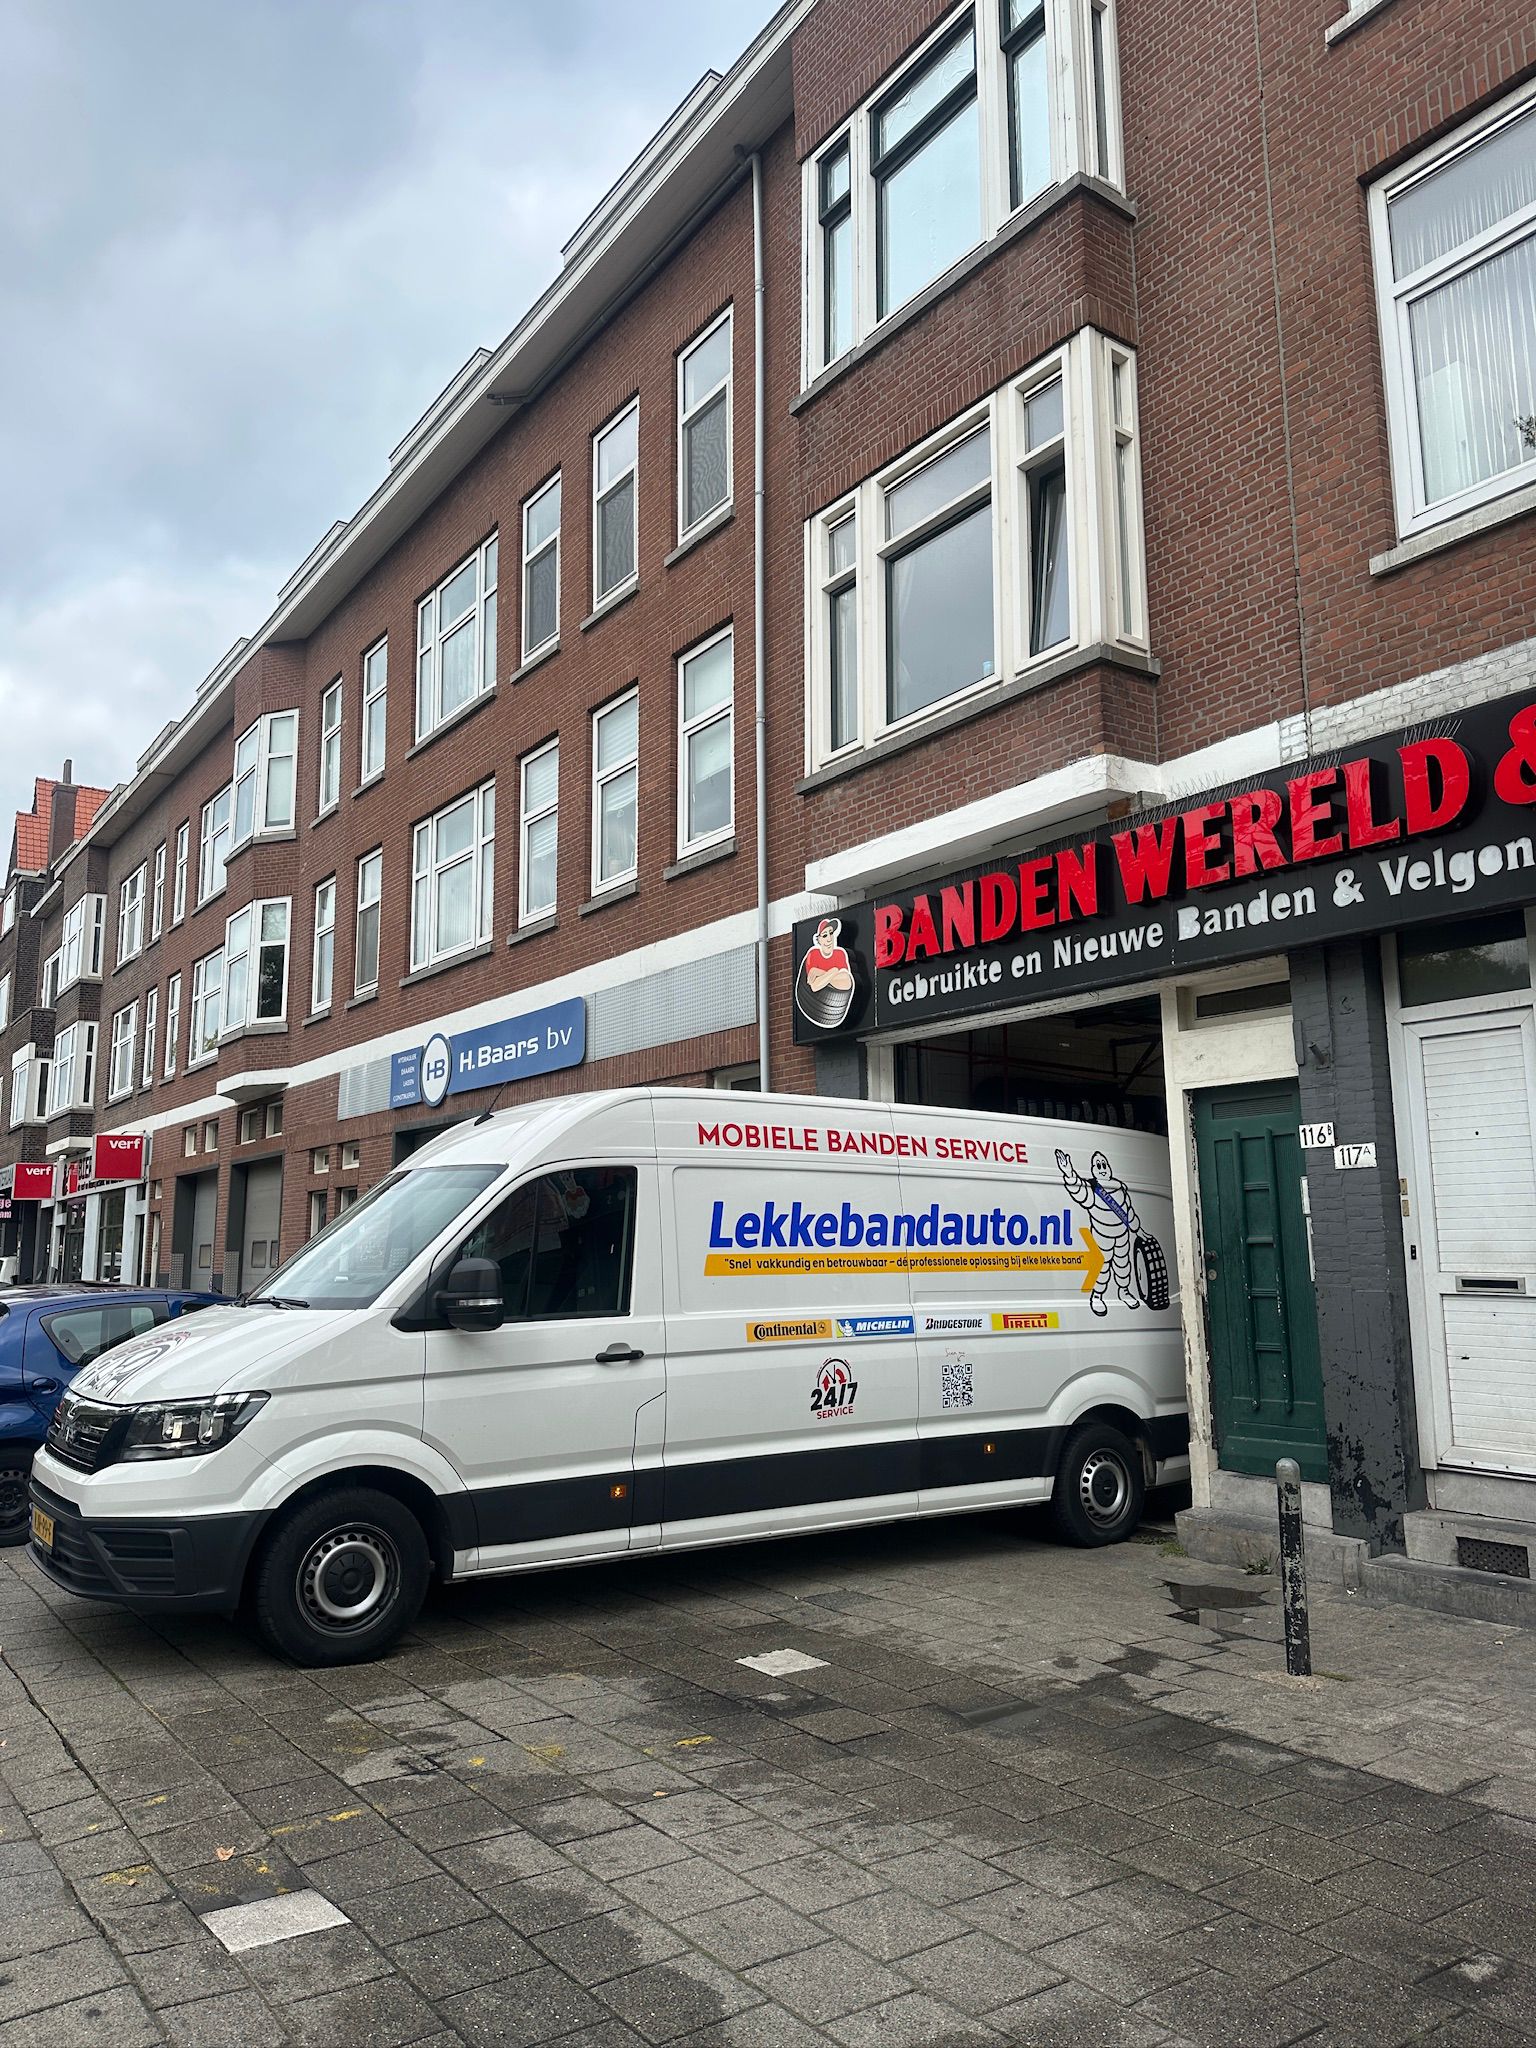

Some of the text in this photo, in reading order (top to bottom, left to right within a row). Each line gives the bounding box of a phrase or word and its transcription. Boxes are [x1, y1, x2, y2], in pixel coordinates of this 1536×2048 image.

[874, 842, 1098, 968] BANDEN
[1111, 737, 1470, 904] WERELD
[888, 957, 1002, 1006] Gebruikte
[1011, 951, 1043, 978] en
[1053, 922, 1165, 969] Nieuwe
[1177, 886, 1317, 941] Banden
[1333, 868, 1366, 908] &
[547, 1026, 573, 1050] bv
[427, 1058, 446, 1081] HB
[109, 1138, 141, 1149] verf
[697, 1122, 1029, 1163] MOBIELE BANDEN SERVICE
[26, 1166, 51, 1176] verf
[709, 1201, 1073, 1248] Lekkebandauto.nl
[756, 1257, 811, 1271] vakkundig
[812, 1259, 825, 1268] en
[826, 1257, 887, 1269] betrouwbaar
[909, 1255, 968, 1269] professionele
[969, 1255, 1010, 1269] oplossing
[1010, 1255, 1021, 1267] bij
[1022, 1255, 1039, 1265] elke
[1040, 1255, 1061, 1265] lekke
[856, 1319, 910, 1332] MICHELIN
[925, 1318, 983, 1330] BRIDGESTONE
[1003, 1313, 1048, 1329] PIRELLI
[754, 1322, 817, 1340] Continental
[811, 1382, 858, 1411] 24/7
[816, 1405, 854, 1419] SERVICE
